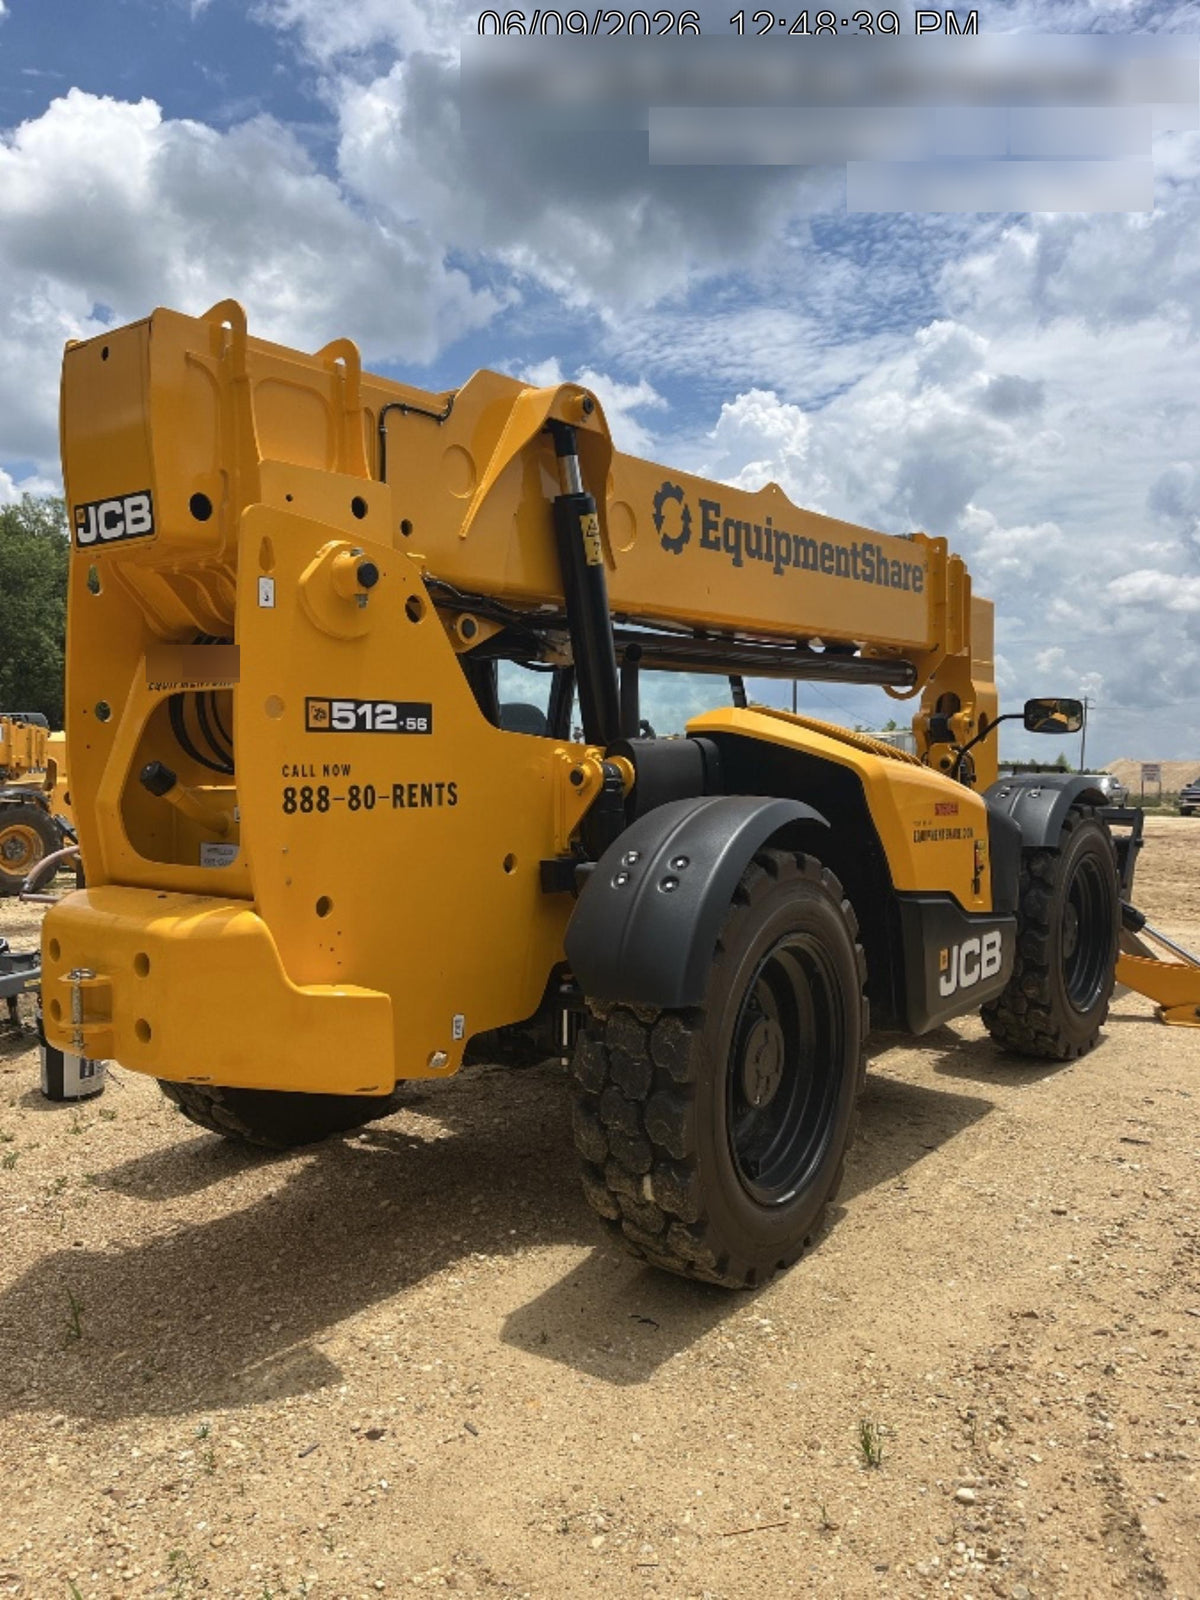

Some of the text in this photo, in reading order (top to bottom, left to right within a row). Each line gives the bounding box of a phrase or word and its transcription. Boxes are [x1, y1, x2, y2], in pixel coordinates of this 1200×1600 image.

[77, 495, 152, 543] JCB
[698, 498, 924, 593] EquipmentShare
[282, 763, 351, 778] CALL NOW
[282, 782, 458, 814] 888-80-RENTS
[939, 930, 1002, 997] JCB
